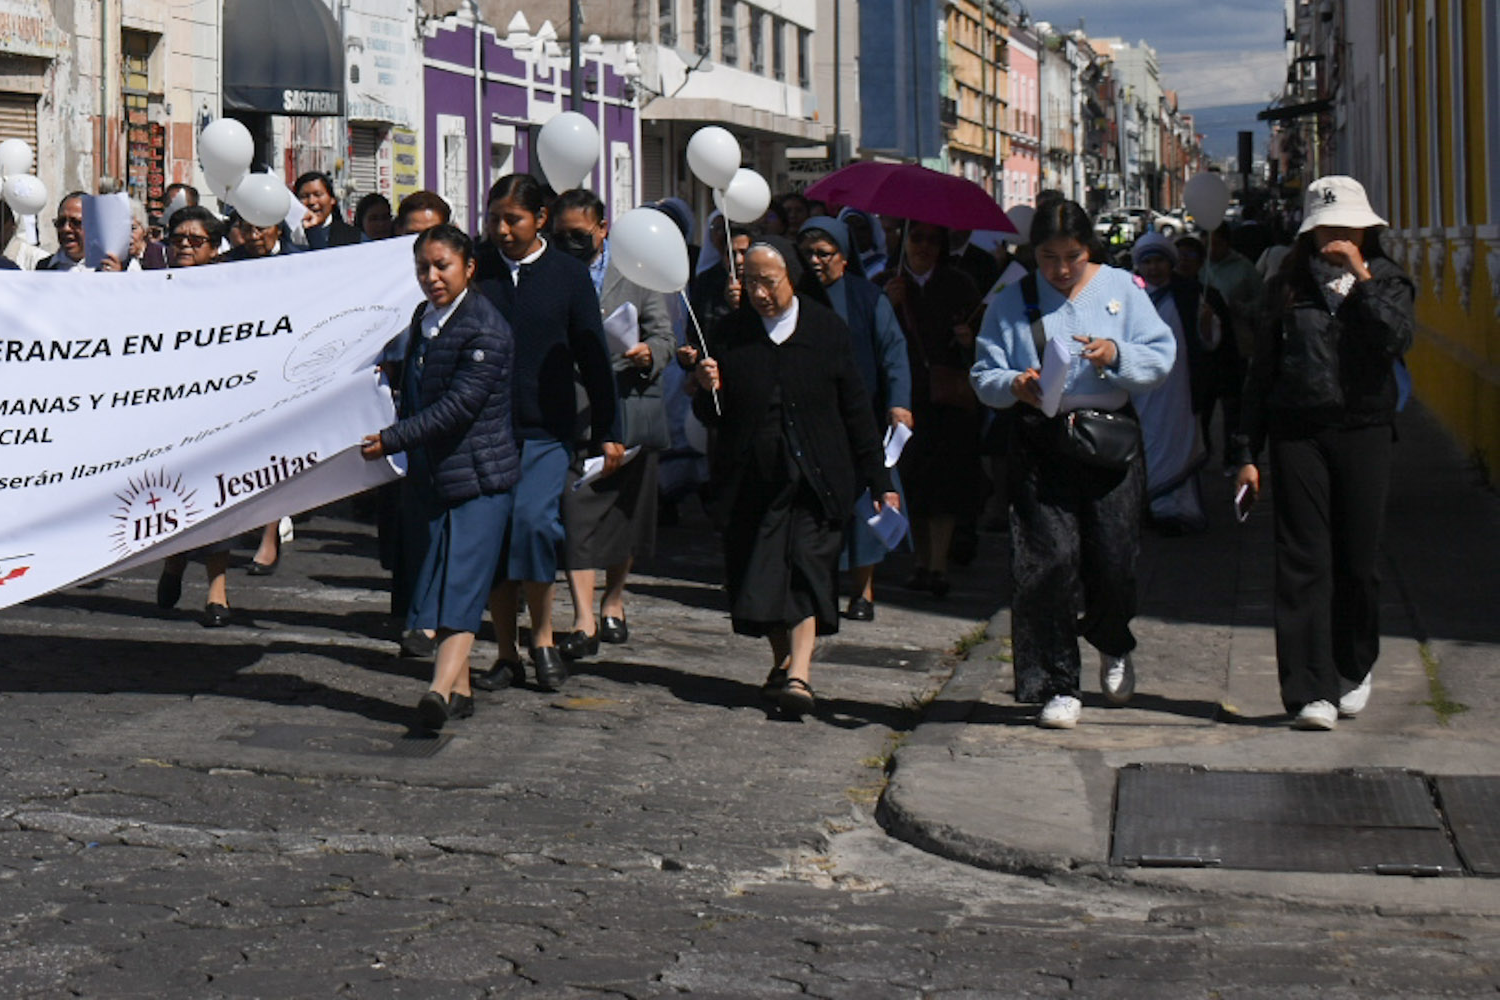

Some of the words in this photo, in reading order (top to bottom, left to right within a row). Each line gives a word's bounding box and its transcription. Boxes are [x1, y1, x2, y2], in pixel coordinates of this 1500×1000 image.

[122, 333, 163, 356] EN
[174, 315, 293, 350] PUEBLA
[89, 393, 106, 410] Y
[111, 370, 258, 408] HERMANOS
[70, 444, 173, 480] llamados
[214, 450, 318, 508] Jesuitas
[133, 508, 179, 541] IHS
